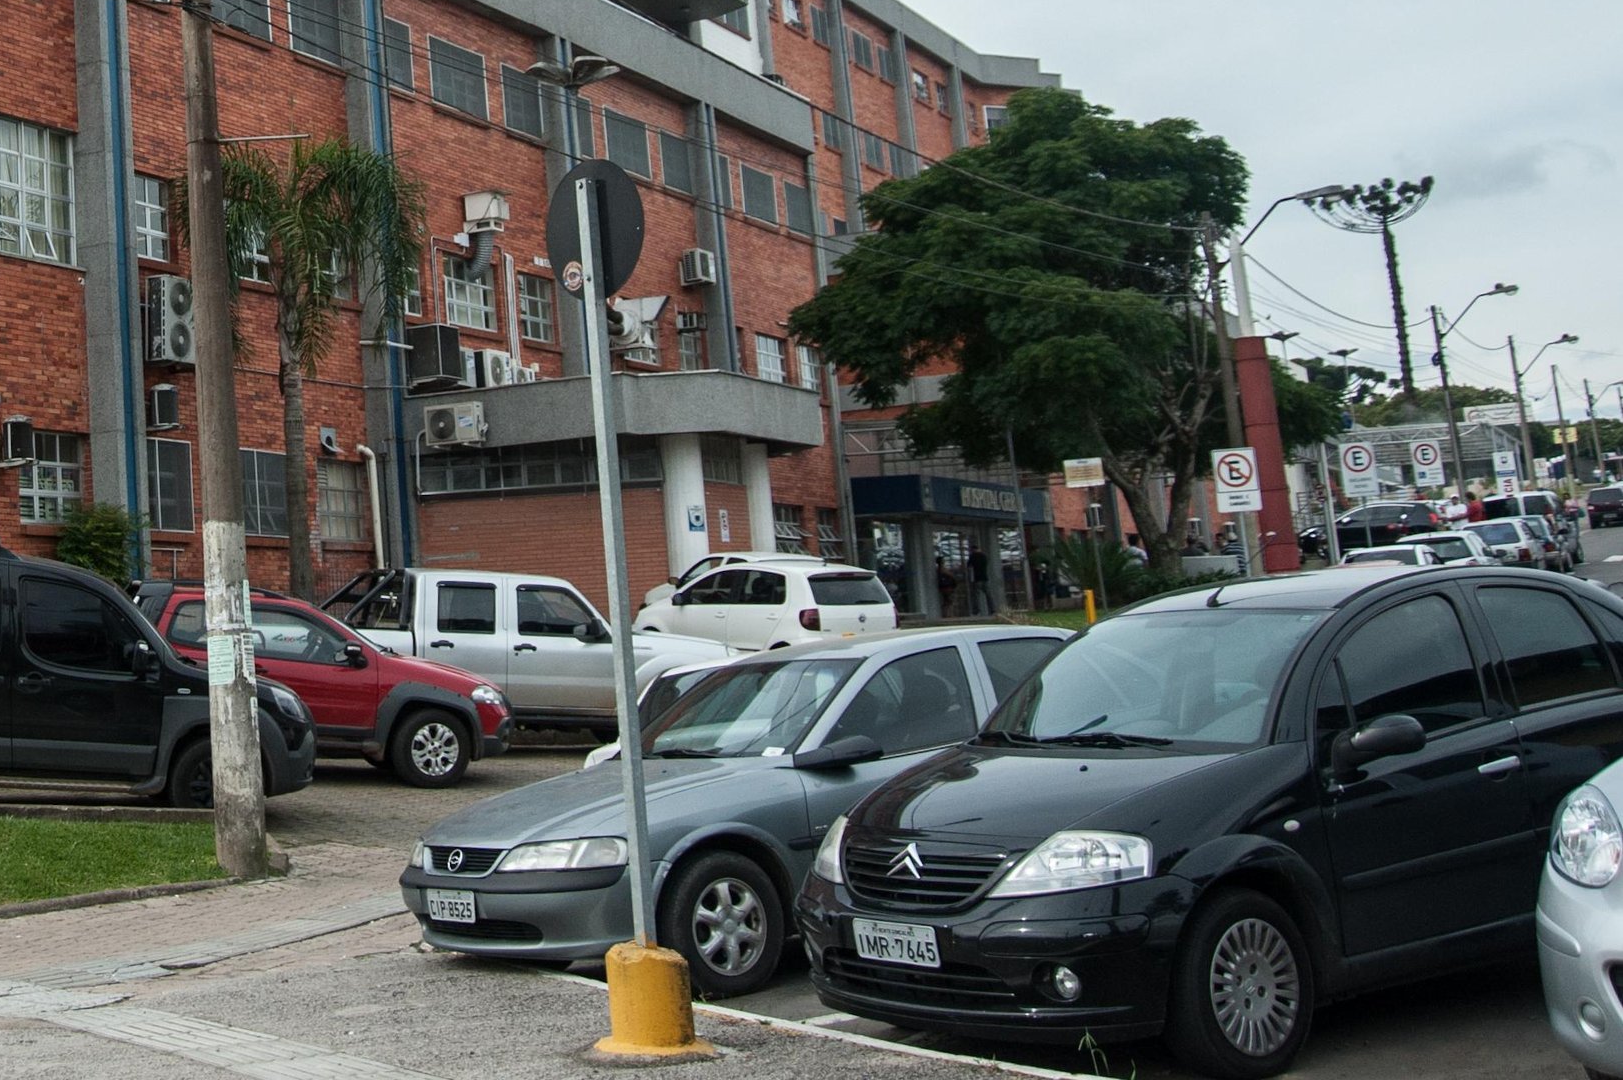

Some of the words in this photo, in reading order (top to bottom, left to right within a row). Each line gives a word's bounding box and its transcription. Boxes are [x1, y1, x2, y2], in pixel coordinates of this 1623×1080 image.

[1352, 451, 1364, 466] E
[1421, 448, 1431, 461] E
[1228, 461, 1243, 480] E
[430, 900, 446, 918] CIP
[448, 901, 473, 918] 8525
